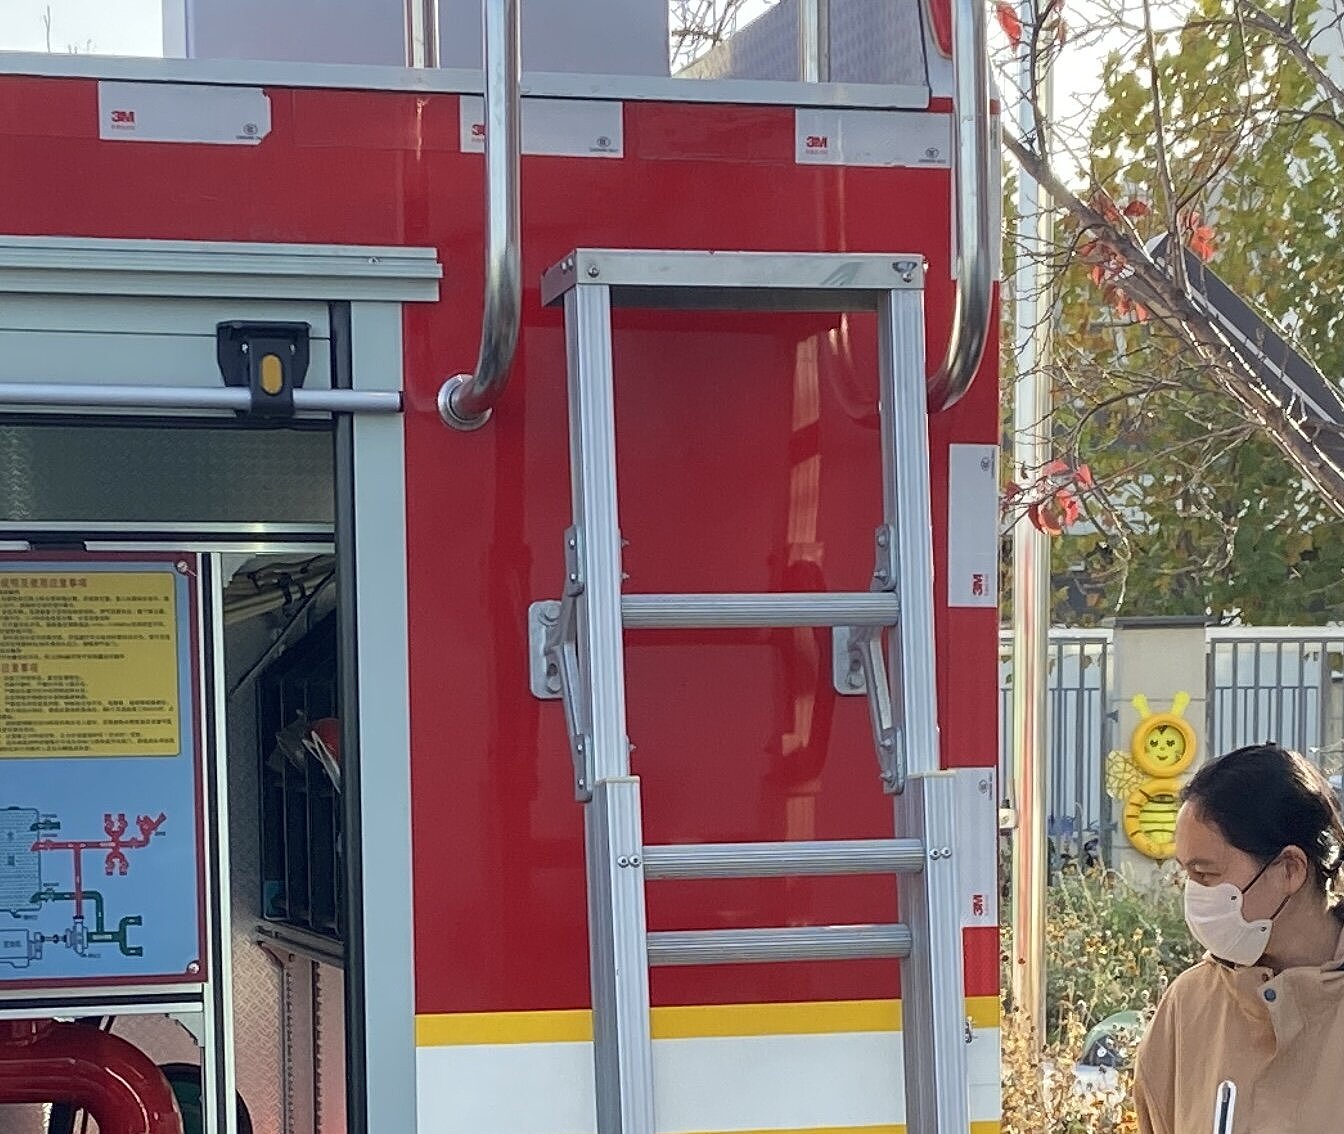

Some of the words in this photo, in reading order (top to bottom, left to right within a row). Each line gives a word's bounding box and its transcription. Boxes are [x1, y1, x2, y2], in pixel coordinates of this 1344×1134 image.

[111, 111, 135, 123] 3M
[806, 136, 828, 148] 3M
[972, 574, 984, 596] 3M
[973, 895, 983, 916] 3M
